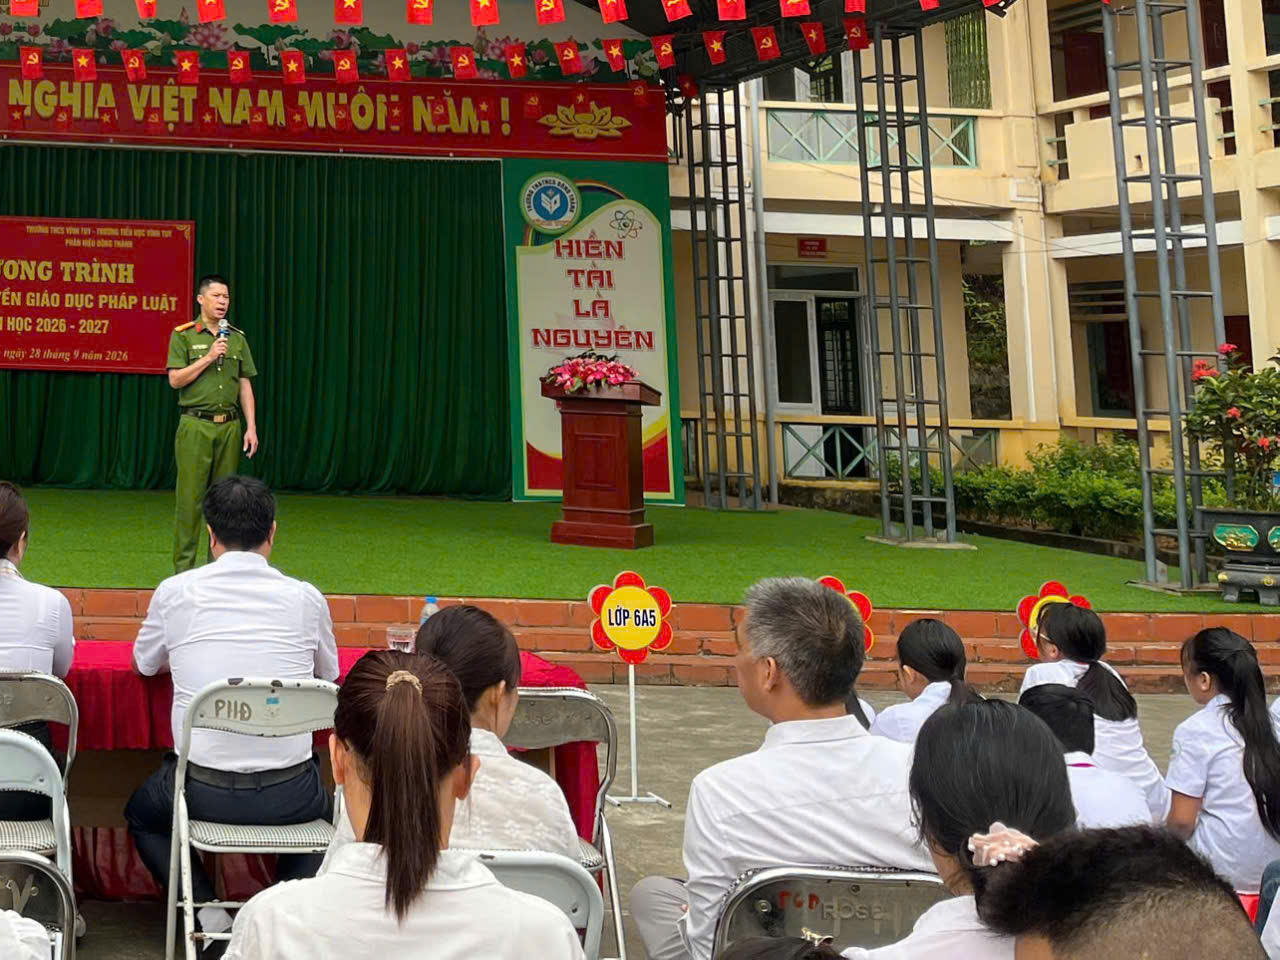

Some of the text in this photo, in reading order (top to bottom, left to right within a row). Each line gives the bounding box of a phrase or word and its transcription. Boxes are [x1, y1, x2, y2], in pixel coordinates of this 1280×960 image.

[127, 77, 199, 133] VIỆT
[208, 86, 287, 127] NAM
[60, 257, 134, 284] TRÌNH
[567, 259, 614, 289] TÀI
[25, 289, 60, 308] GIÁO
[64, 293, 94, 311] DỤC
[98, 292, 138, 310] PHÁP
[142, 293, 178, 315] LUẬT
[573, 289, 610, 318] LÀ
[6, 316, 33, 335] HỌC
[36, 318, 66, 333] 2026
[78, 319, 110, 334] 2027
[531, 325, 654, 351] NGUYÊN
[29, 348, 41, 358] 28
[43, 348, 71, 363] tháng
[81, 350, 103, 360] năm
[105, 350, 129, 361] 2026
[608, 605, 656, 627] LỚP 6A5
